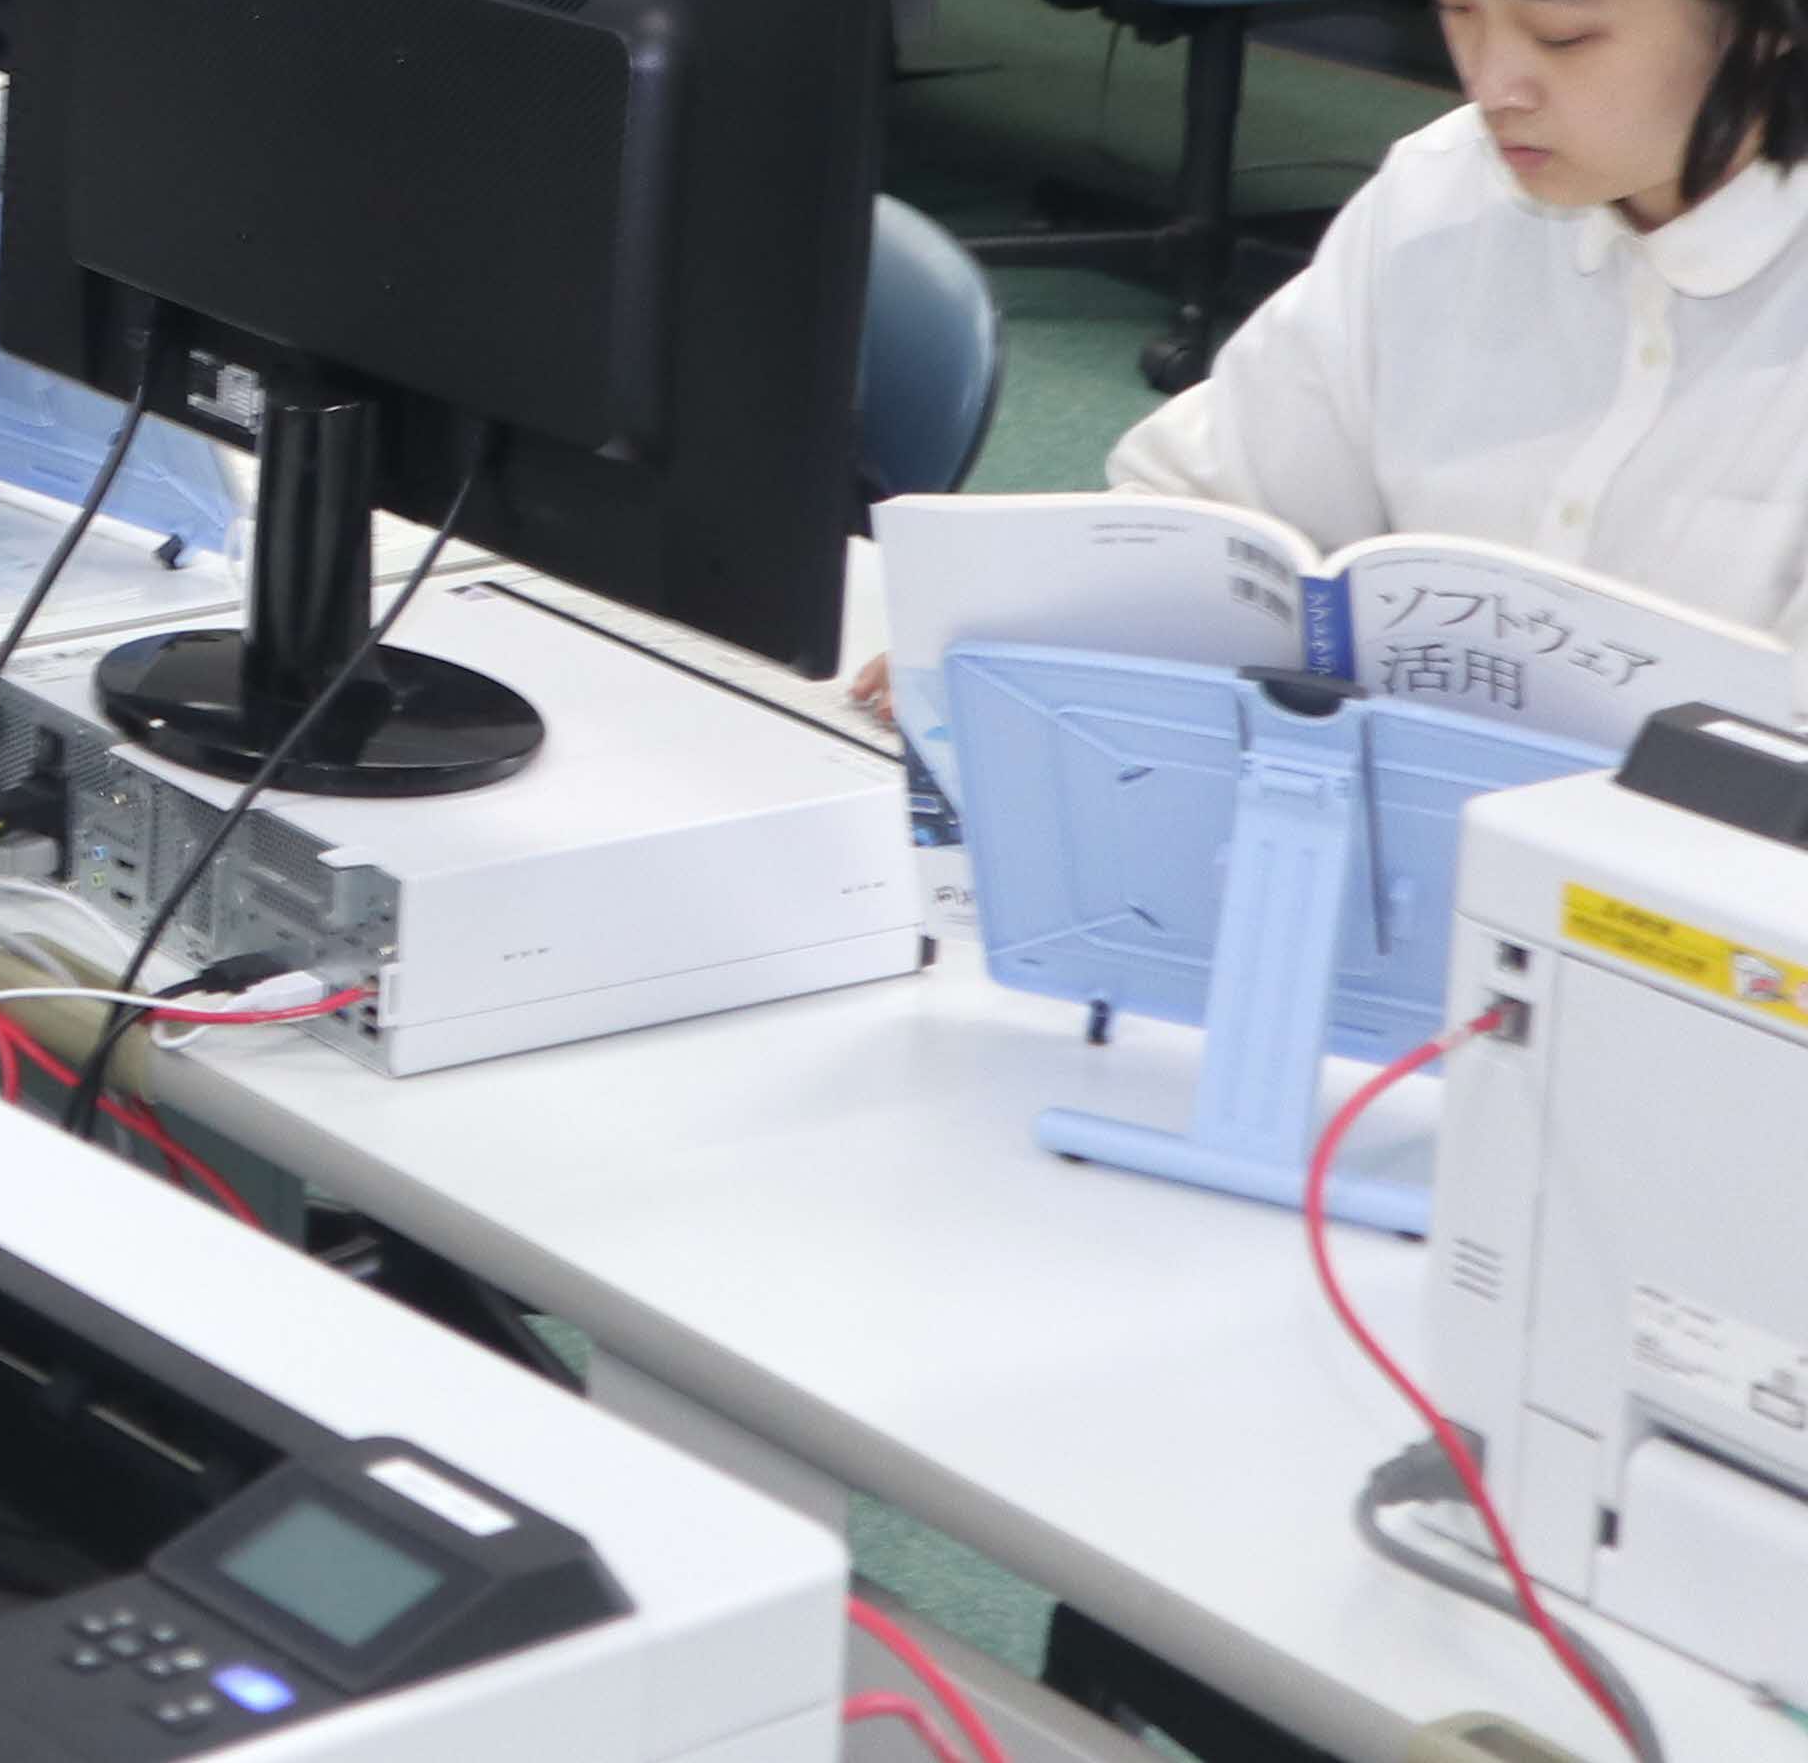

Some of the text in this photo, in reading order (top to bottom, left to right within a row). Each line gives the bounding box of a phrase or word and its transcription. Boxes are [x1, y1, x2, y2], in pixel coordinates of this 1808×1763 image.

[1379, 586, 1659, 687] ソフトウェア
[1379, 642, 1525, 711] 活用
